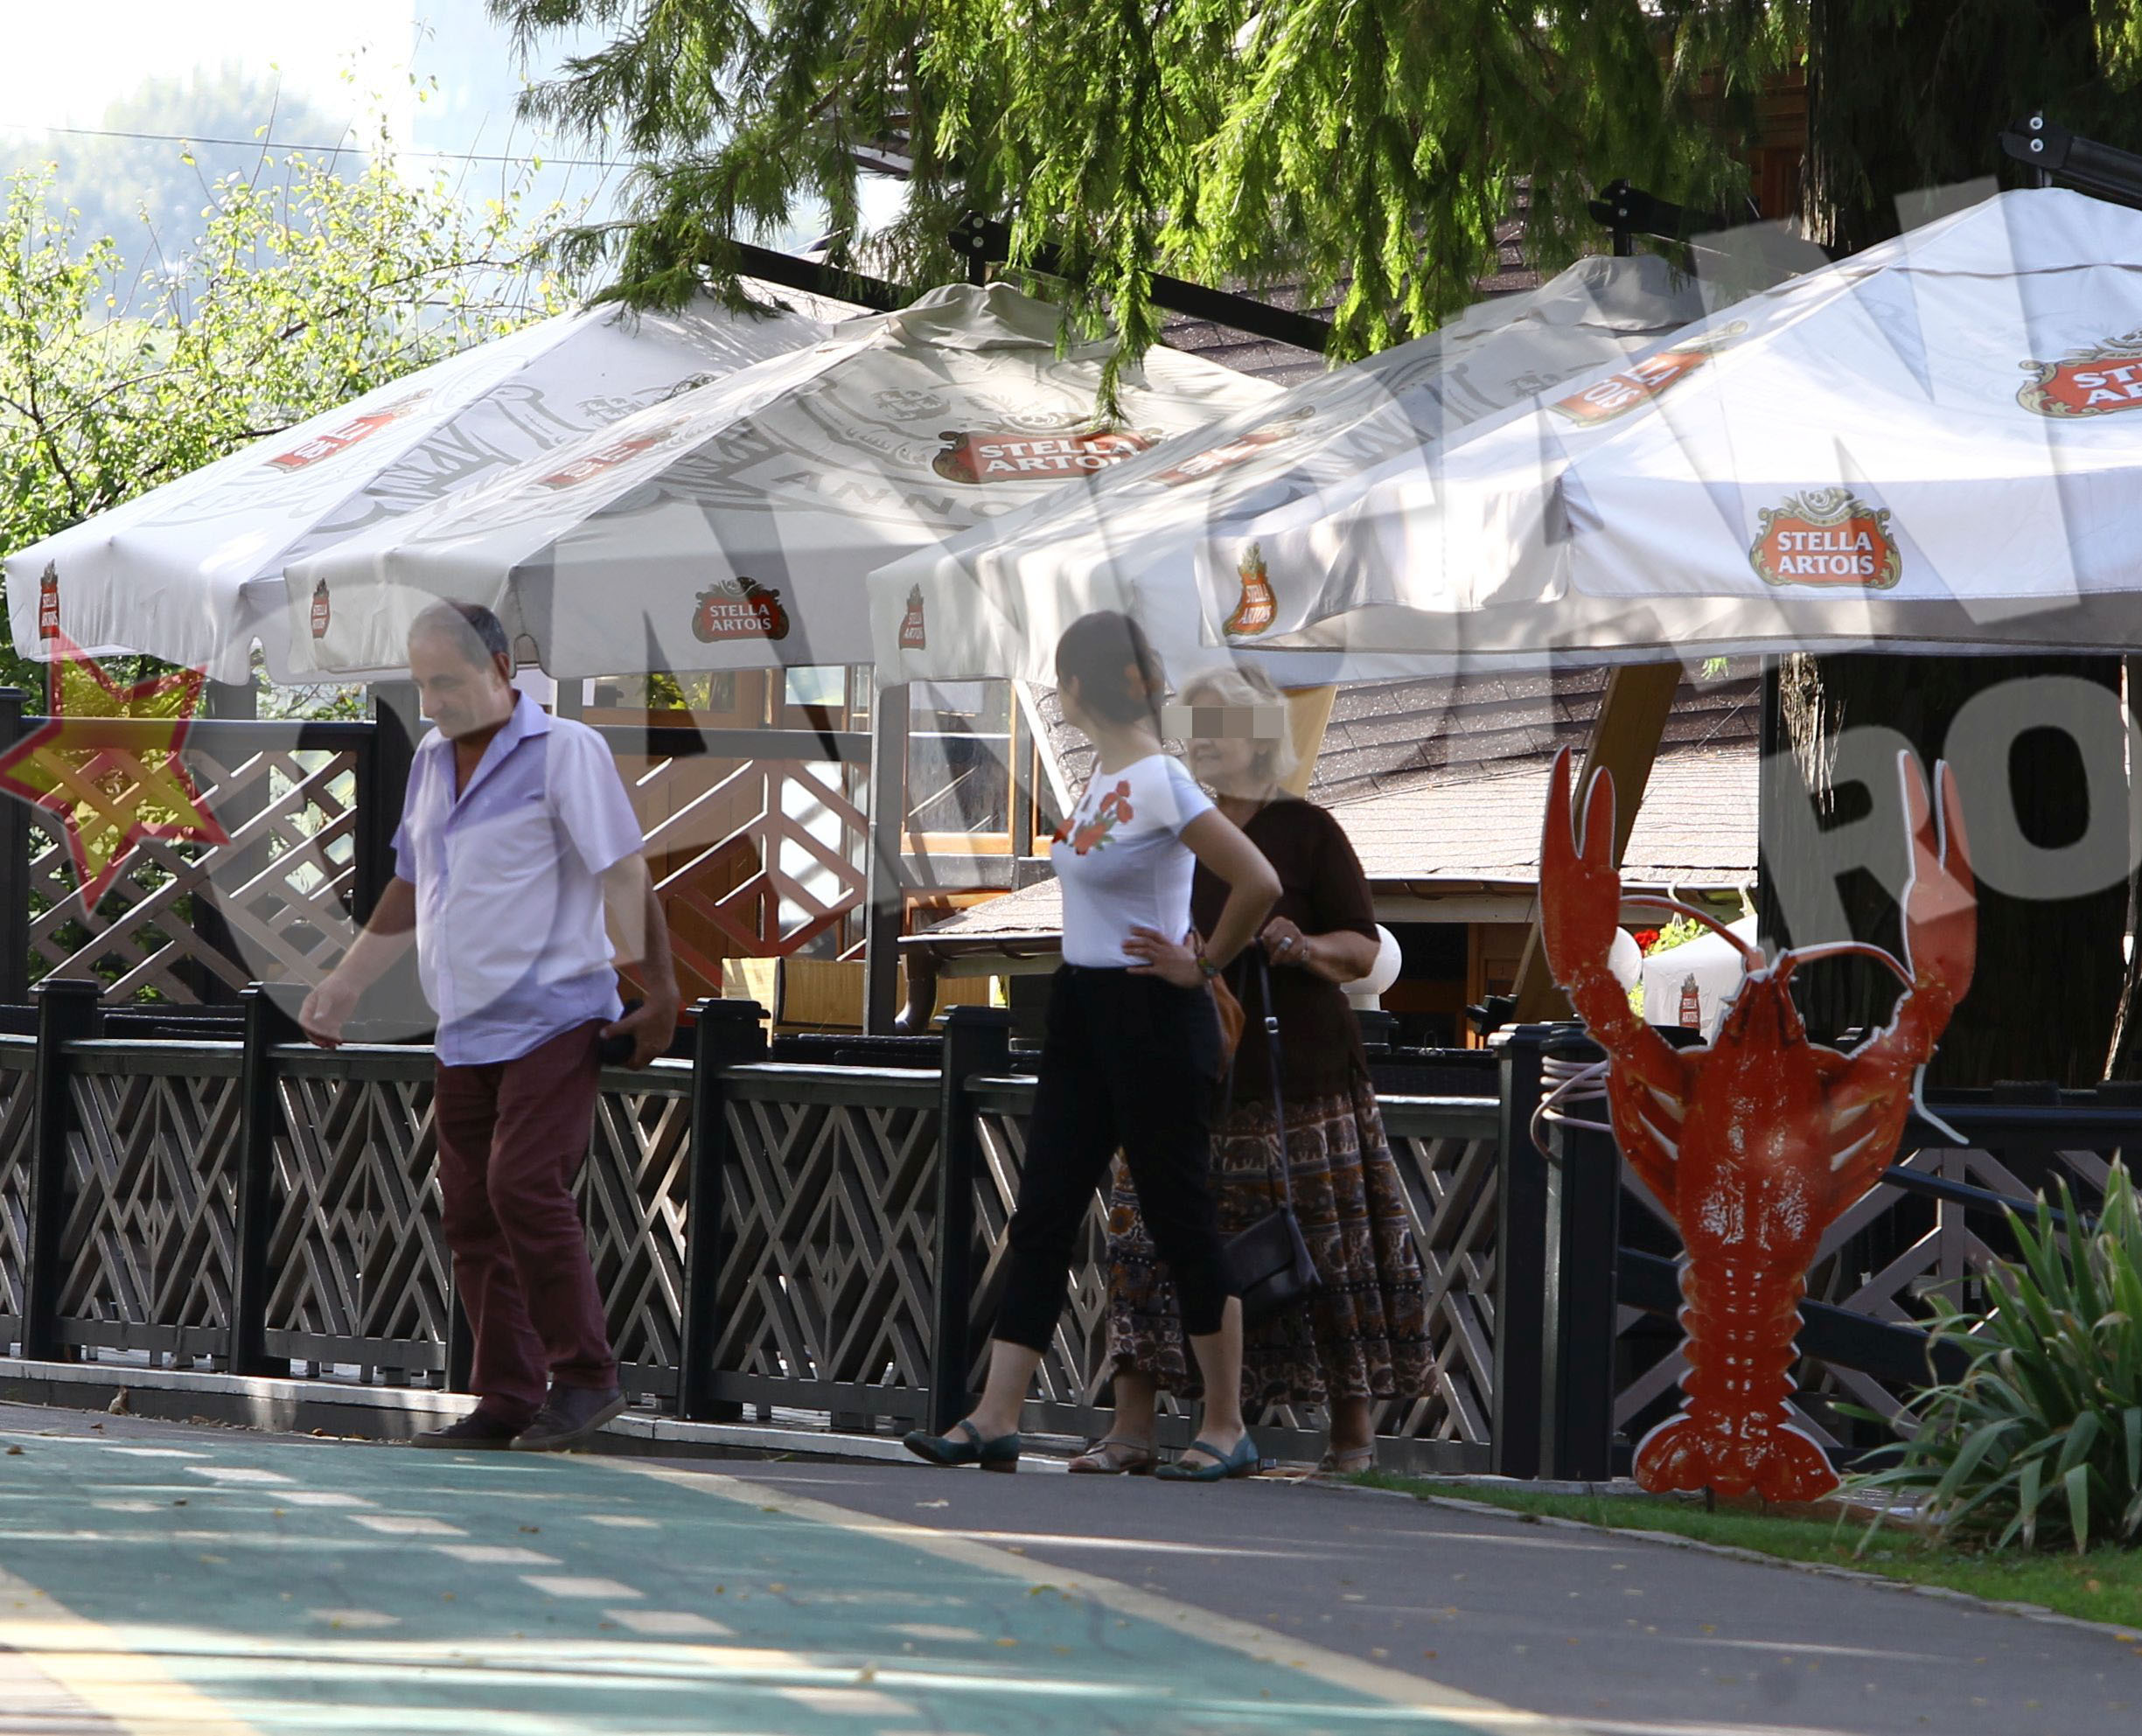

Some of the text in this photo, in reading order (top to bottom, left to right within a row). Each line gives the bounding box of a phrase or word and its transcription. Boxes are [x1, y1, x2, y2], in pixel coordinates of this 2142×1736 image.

[978, 440, 1141, 458] STELLA
[986, 455, 1122, 472] ARTOI
[1776, 531, 1873, 551] STELLA
[1778, 554, 1875, 575] ARTOIS
[709, 603, 770, 617] STELLA
[712, 617, 771, 631] ARTOIS
